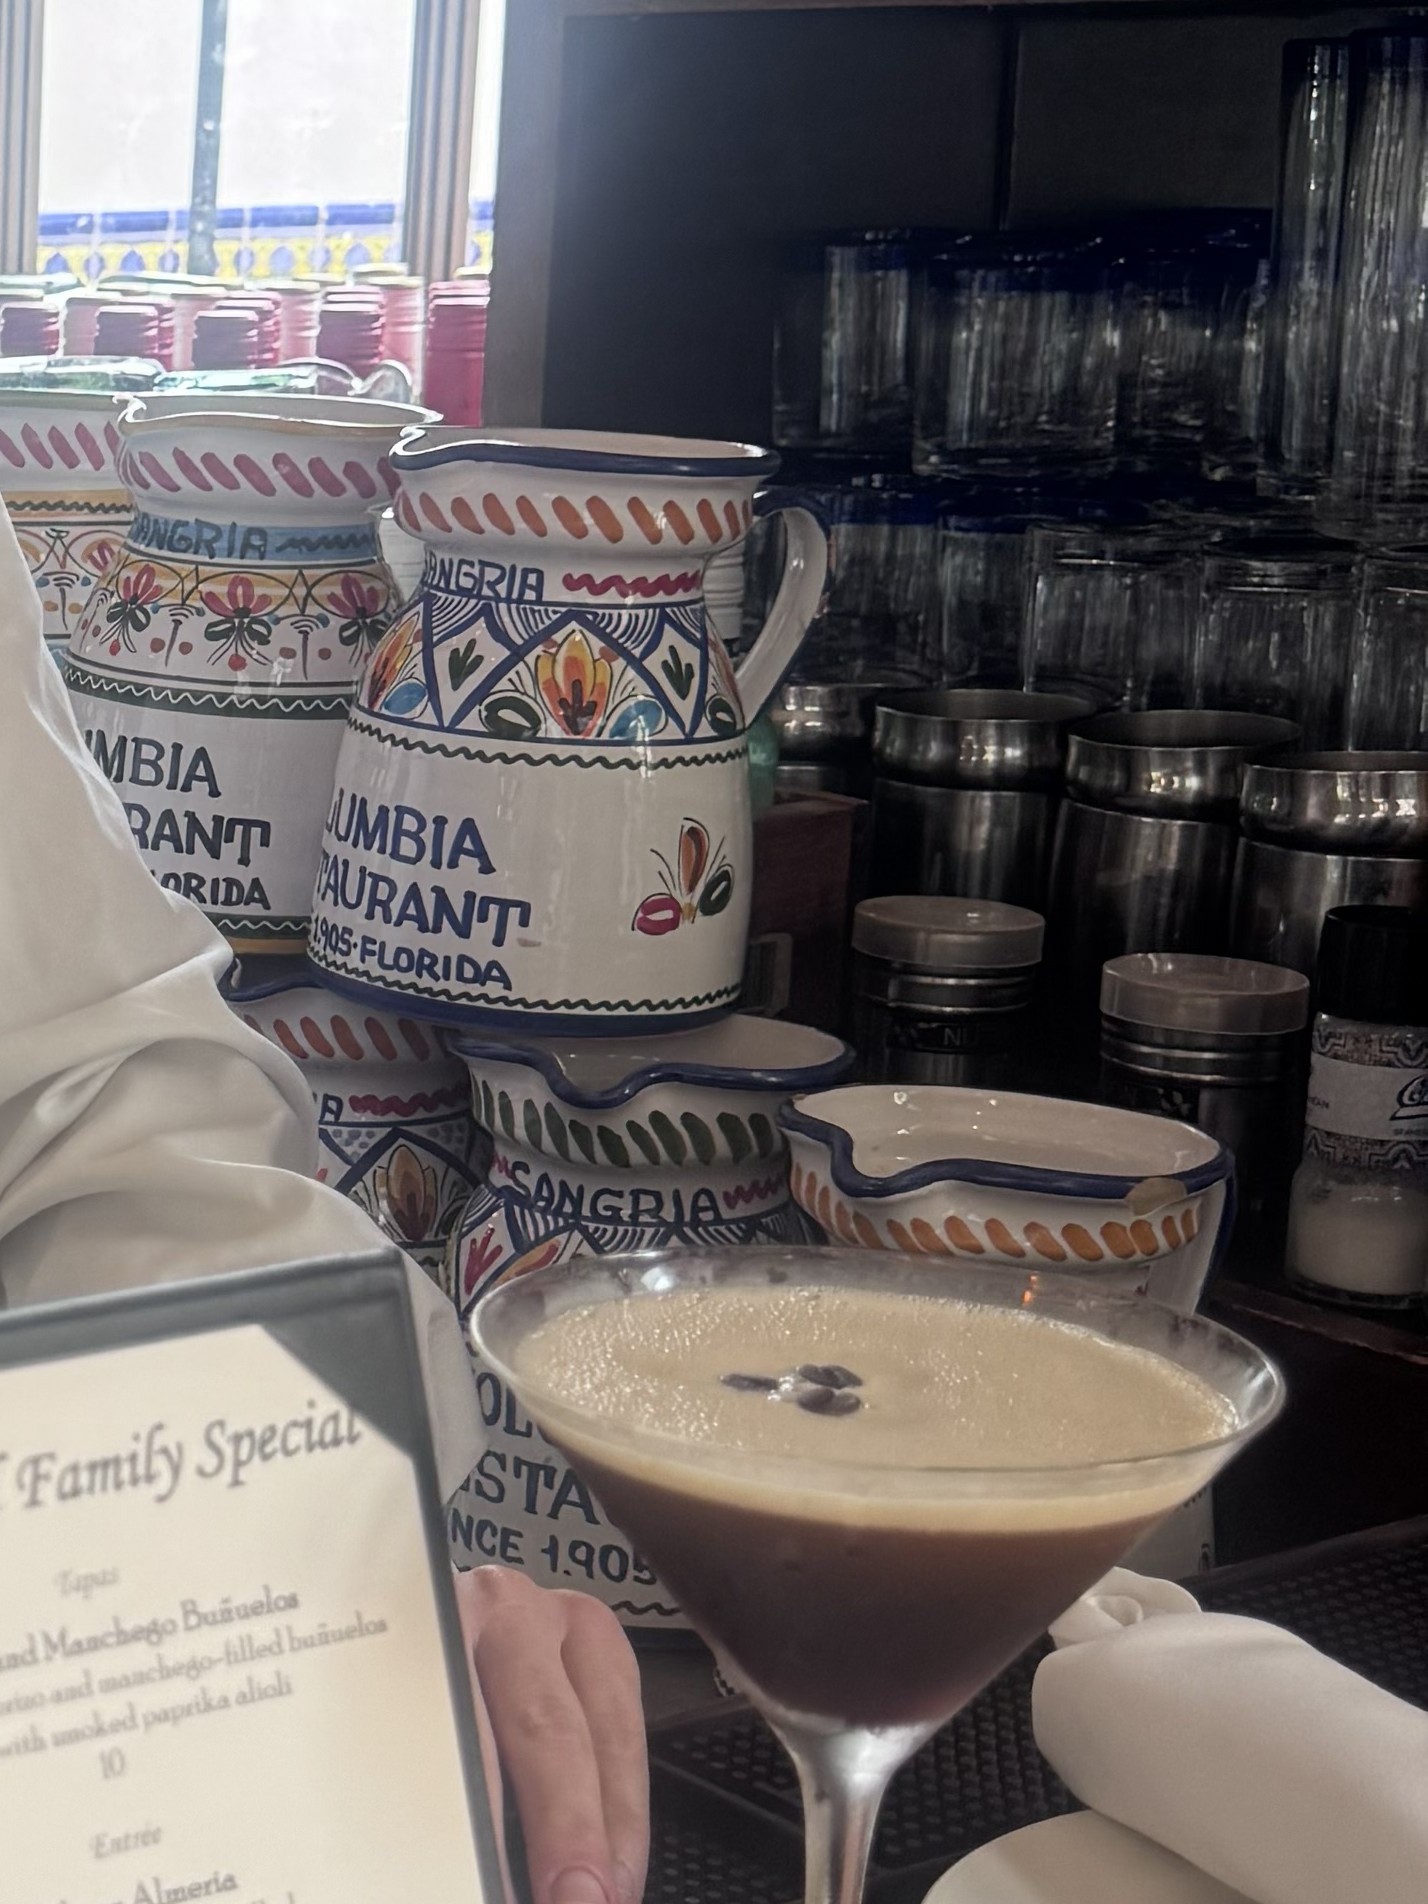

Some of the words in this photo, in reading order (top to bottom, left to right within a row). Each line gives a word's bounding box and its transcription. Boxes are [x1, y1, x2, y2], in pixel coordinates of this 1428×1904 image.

[509, 1159, 724, 1229] SANGRIA
[19, 1429, 181, 1509] Family
[39, 1614, 179, 1664] Manchego
[178, 1583, 302, 1635] Buñuelos
[49, 1703, 140, 1749] smoked
[140, 1686, 233, 1738] paprika
[233, 1670, 294, 1708] alioli
[99, 1749, 126, 1782] 10
